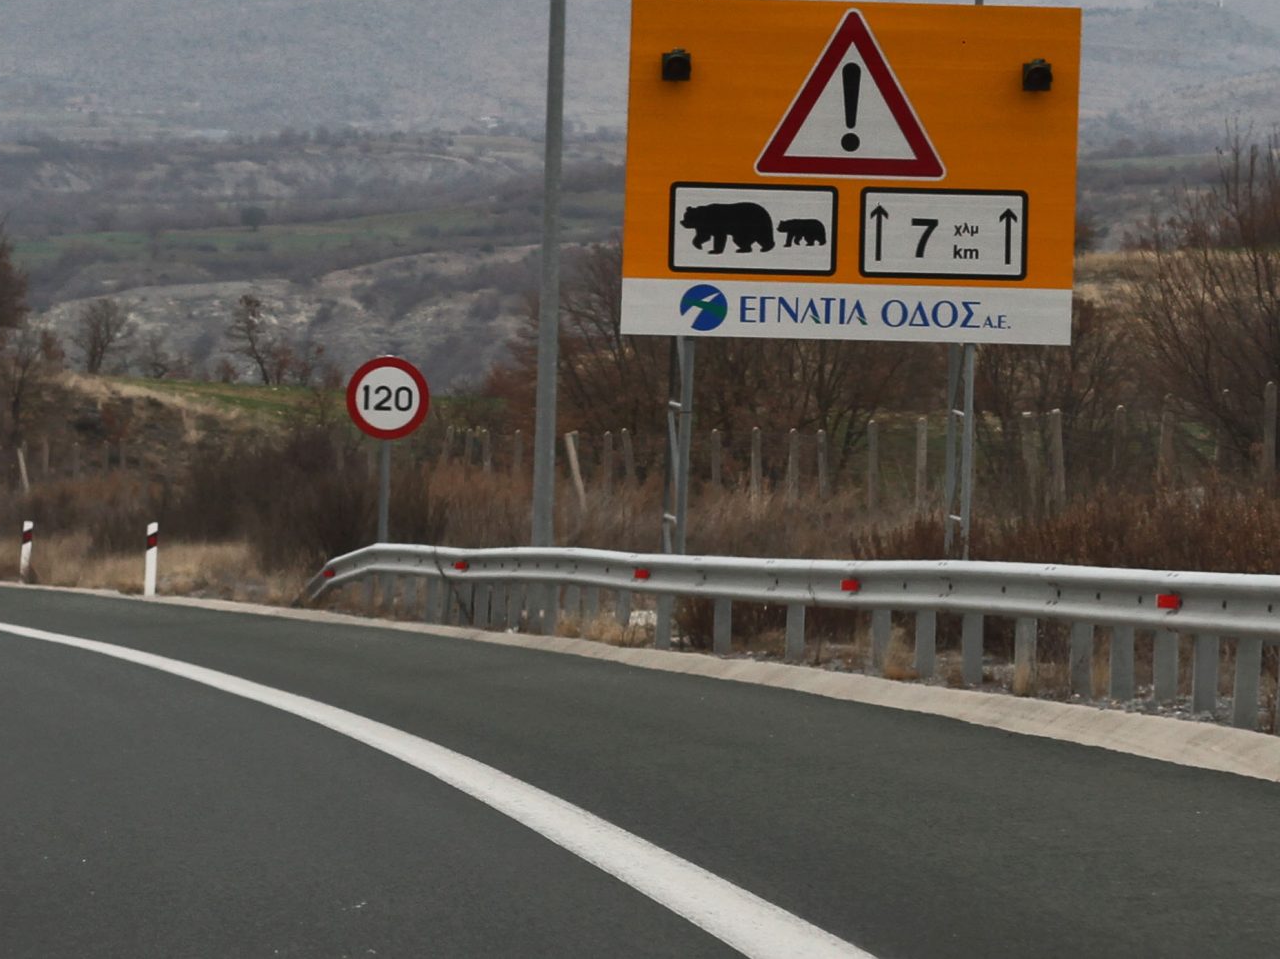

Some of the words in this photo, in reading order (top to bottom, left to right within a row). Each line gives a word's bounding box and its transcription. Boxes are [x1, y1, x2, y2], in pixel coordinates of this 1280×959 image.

[911, 218, 939, 259] 7
[953, 223, 979, 237] χλμ
[953, 244, 979, 259] km
[739, 295, 868, 326] ΕΓΝΑΤΙΑ
[881, 299, 981, 329] ΟΔΟΣ
[363, 384, 413, 412] 120
